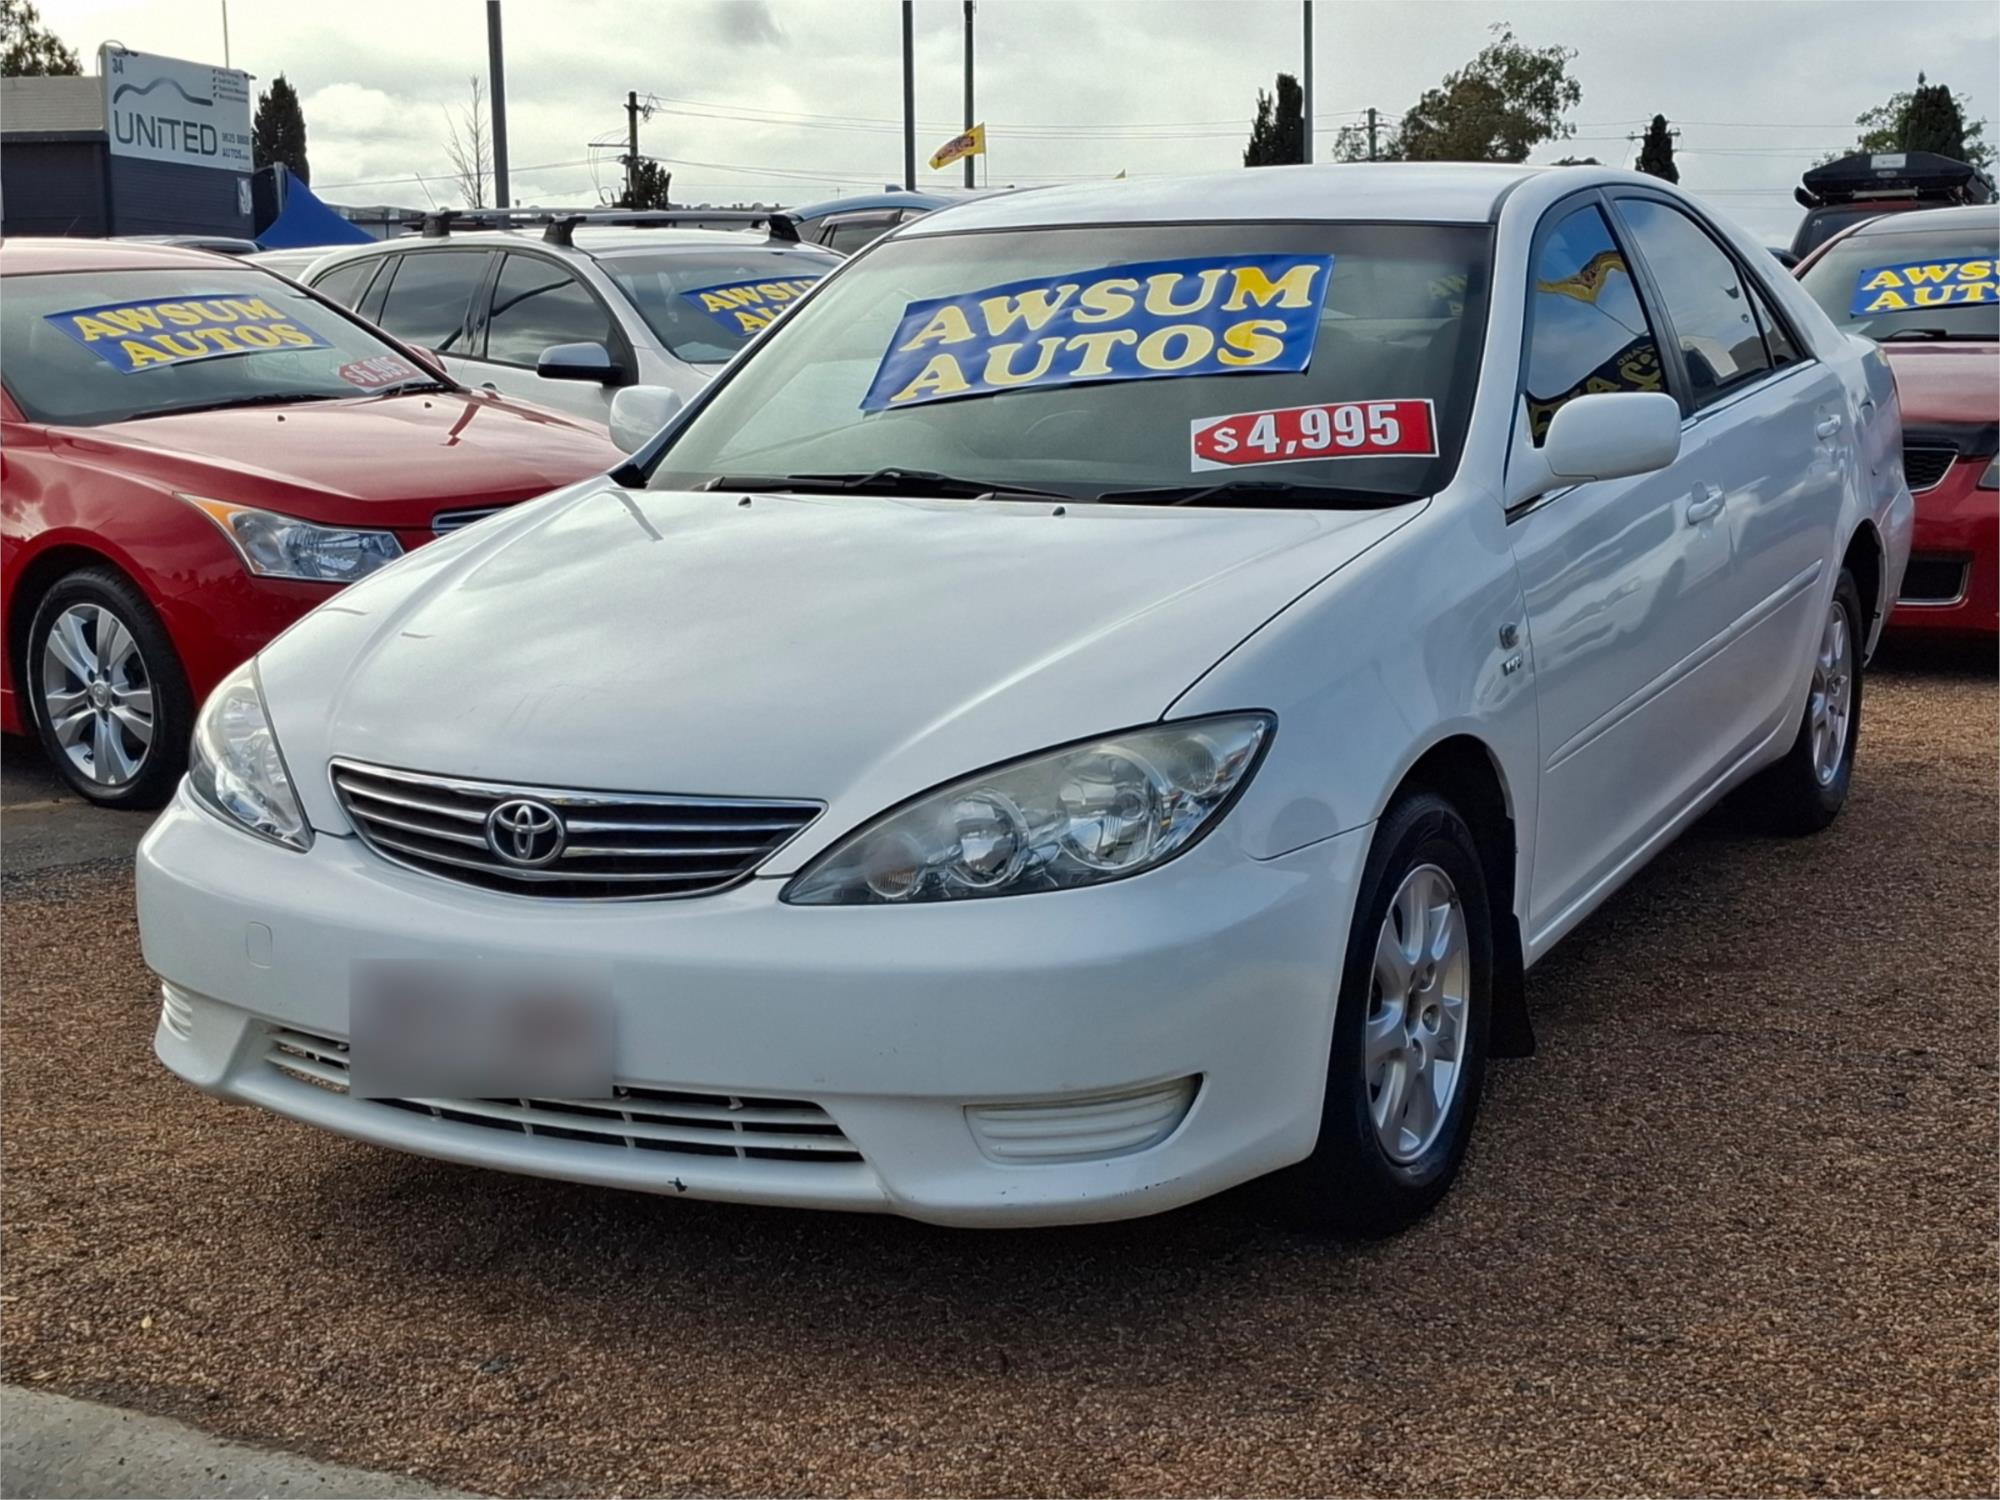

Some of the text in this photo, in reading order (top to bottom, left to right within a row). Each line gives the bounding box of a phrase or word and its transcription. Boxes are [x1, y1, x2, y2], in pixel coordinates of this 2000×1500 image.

[112, 58, 123, 74] 34
[113, 110, 217, 156] UNITED
[1861, 260, 2000, 291] AWS
[1865, 282, 2000, 311] AUT
[73, 299, 286, 342] AWSUM
[898, 265, 1320, 351] AWSUM
[120, 323, 313, 367] AUTOS
[890, 320, 1287, 401] AUTOS
[1213, 403, 1400, 455] $4,995
